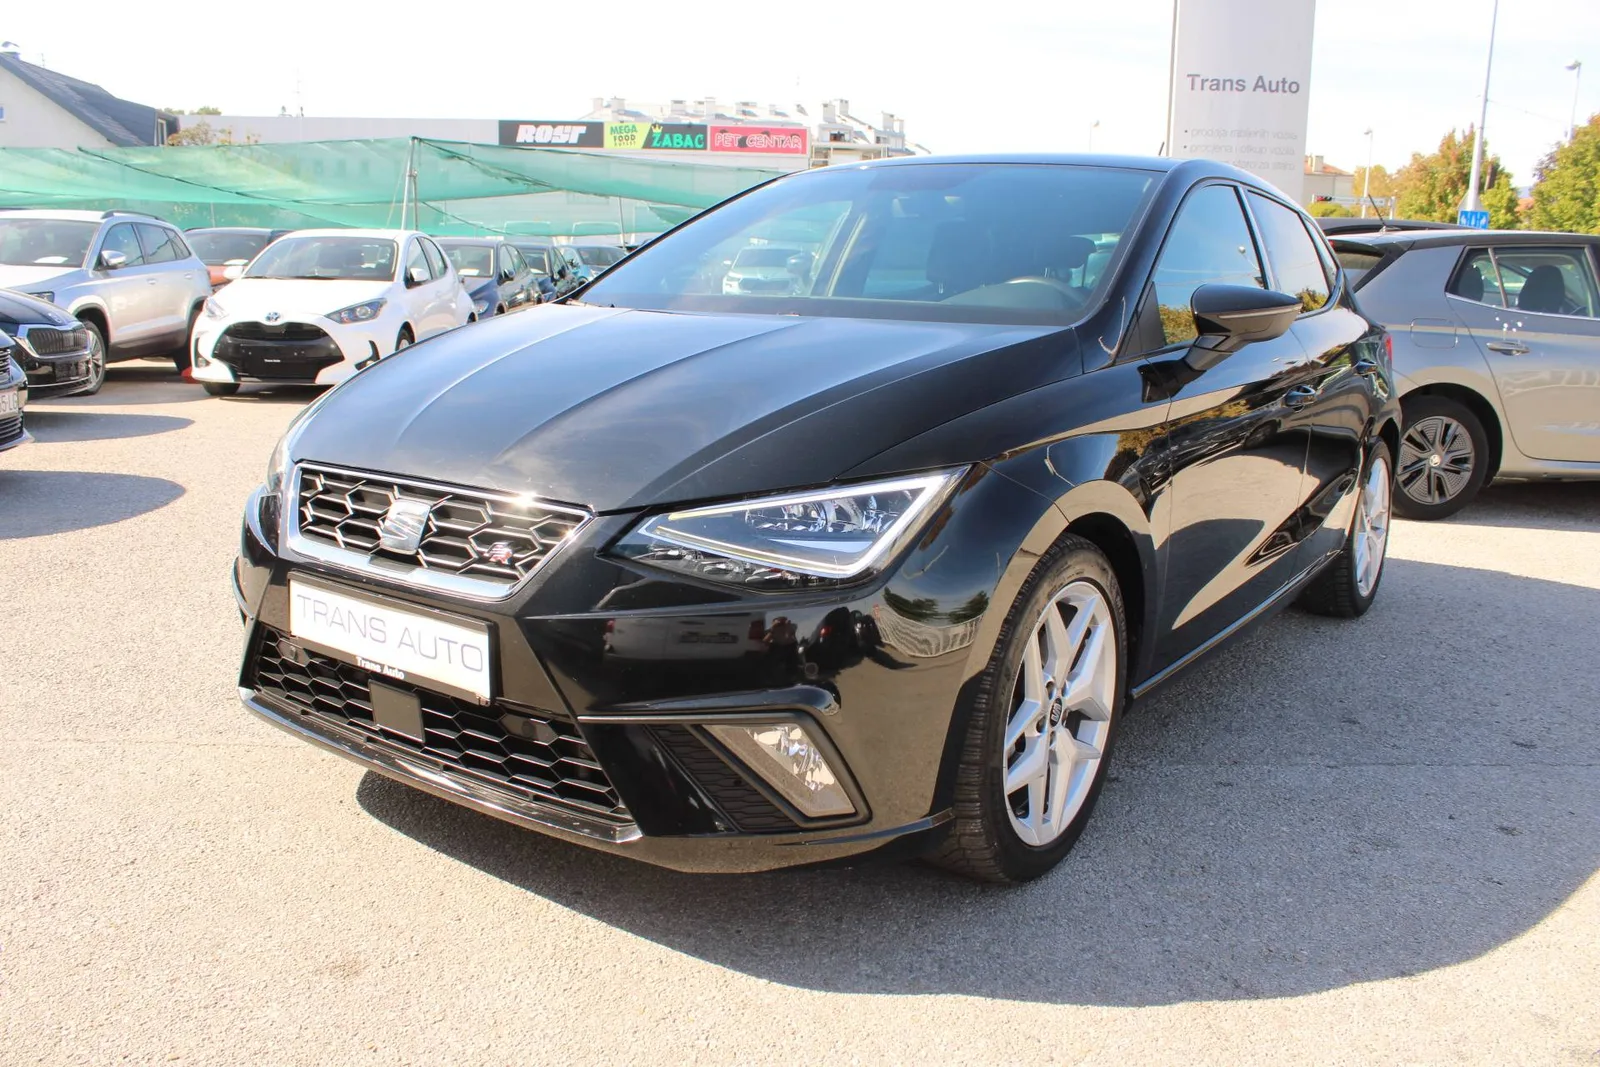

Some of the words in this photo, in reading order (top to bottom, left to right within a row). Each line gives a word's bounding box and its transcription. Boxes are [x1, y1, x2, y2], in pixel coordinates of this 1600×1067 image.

[1187, 73, 1246, 92] Trans
[1252, 75, 1300, 94] Auto
[516, 124, 587, 144] ROST
[609, 124, 638, 135] MEGA
[613, 134, 636, 142] FOOD
[715, 132, 742, 148] PET
[746, 133, 802, 149] CENTAR
[297, 594, 387, 644] TRANS
[398, 627, 483, 672] AUTO
[356, 656, 382, 673] Trans
[383, 664, 405, 680] Auto
